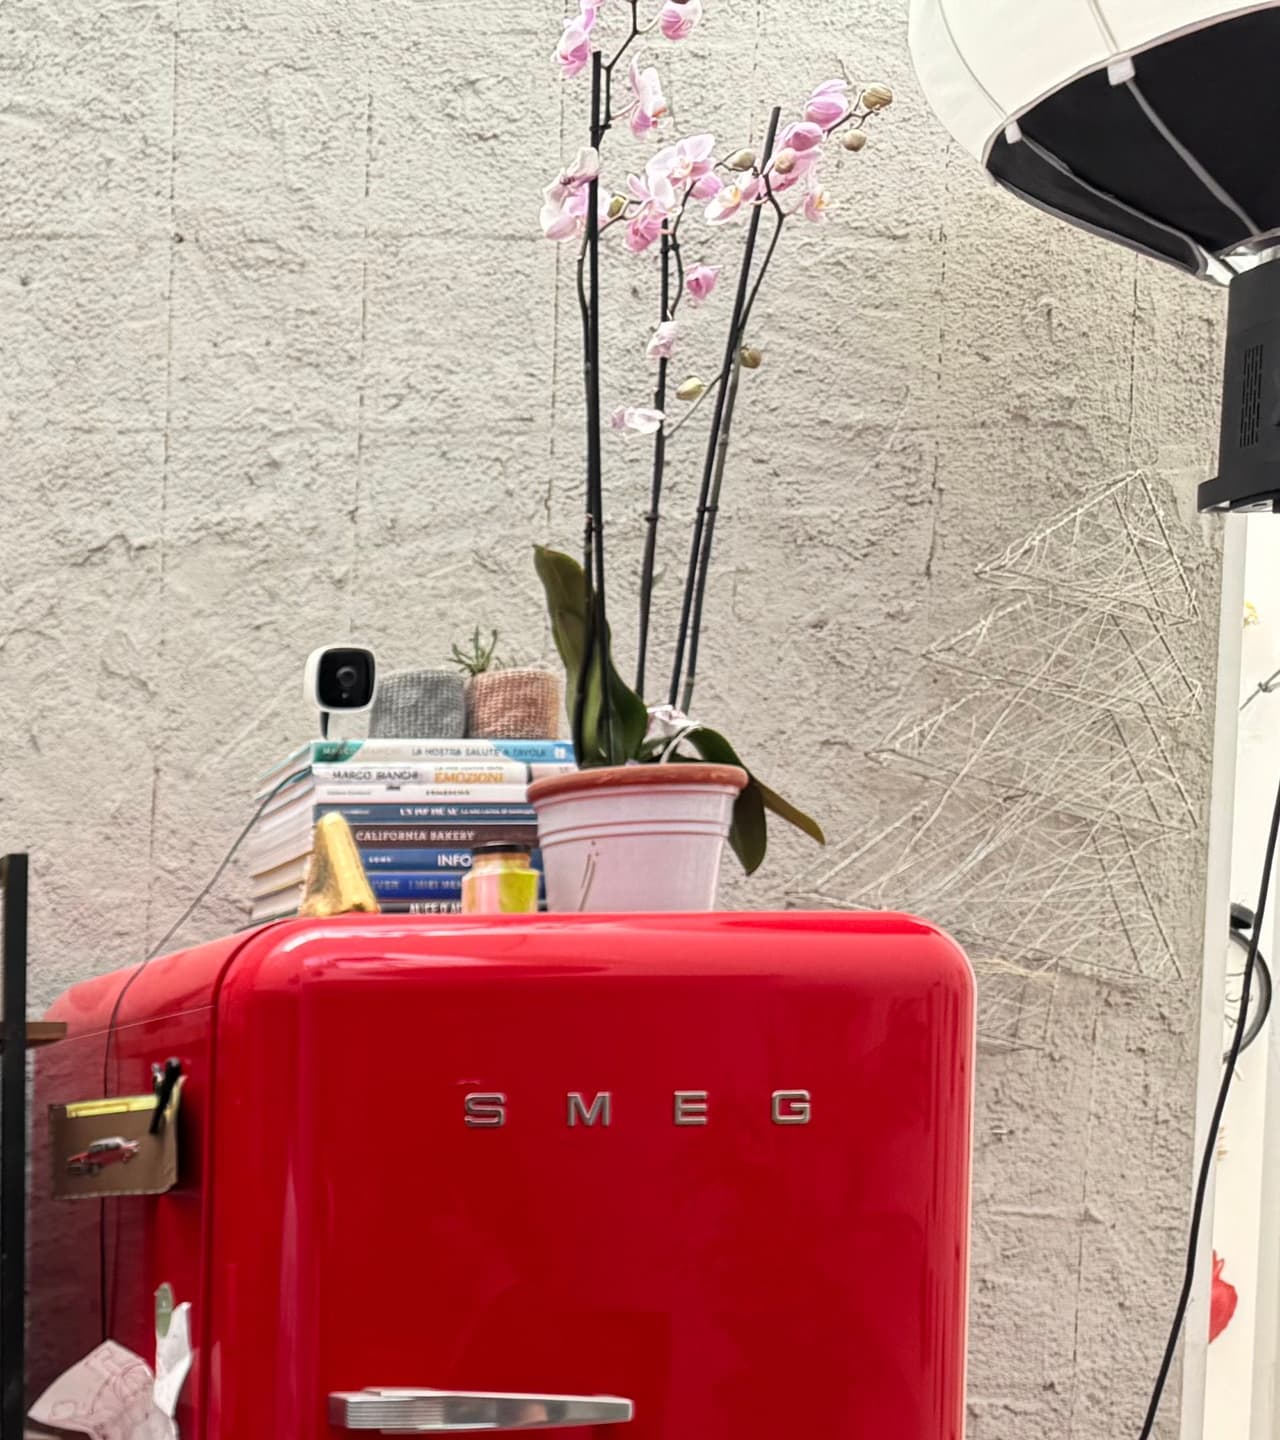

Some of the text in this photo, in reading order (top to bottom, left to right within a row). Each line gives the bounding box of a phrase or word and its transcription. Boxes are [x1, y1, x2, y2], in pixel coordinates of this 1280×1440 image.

[332, 771, 504, 784] MARCO BIANCHI EMOZIONI
[355, 831, 475, 841] CALIFORNIA BAKERY
